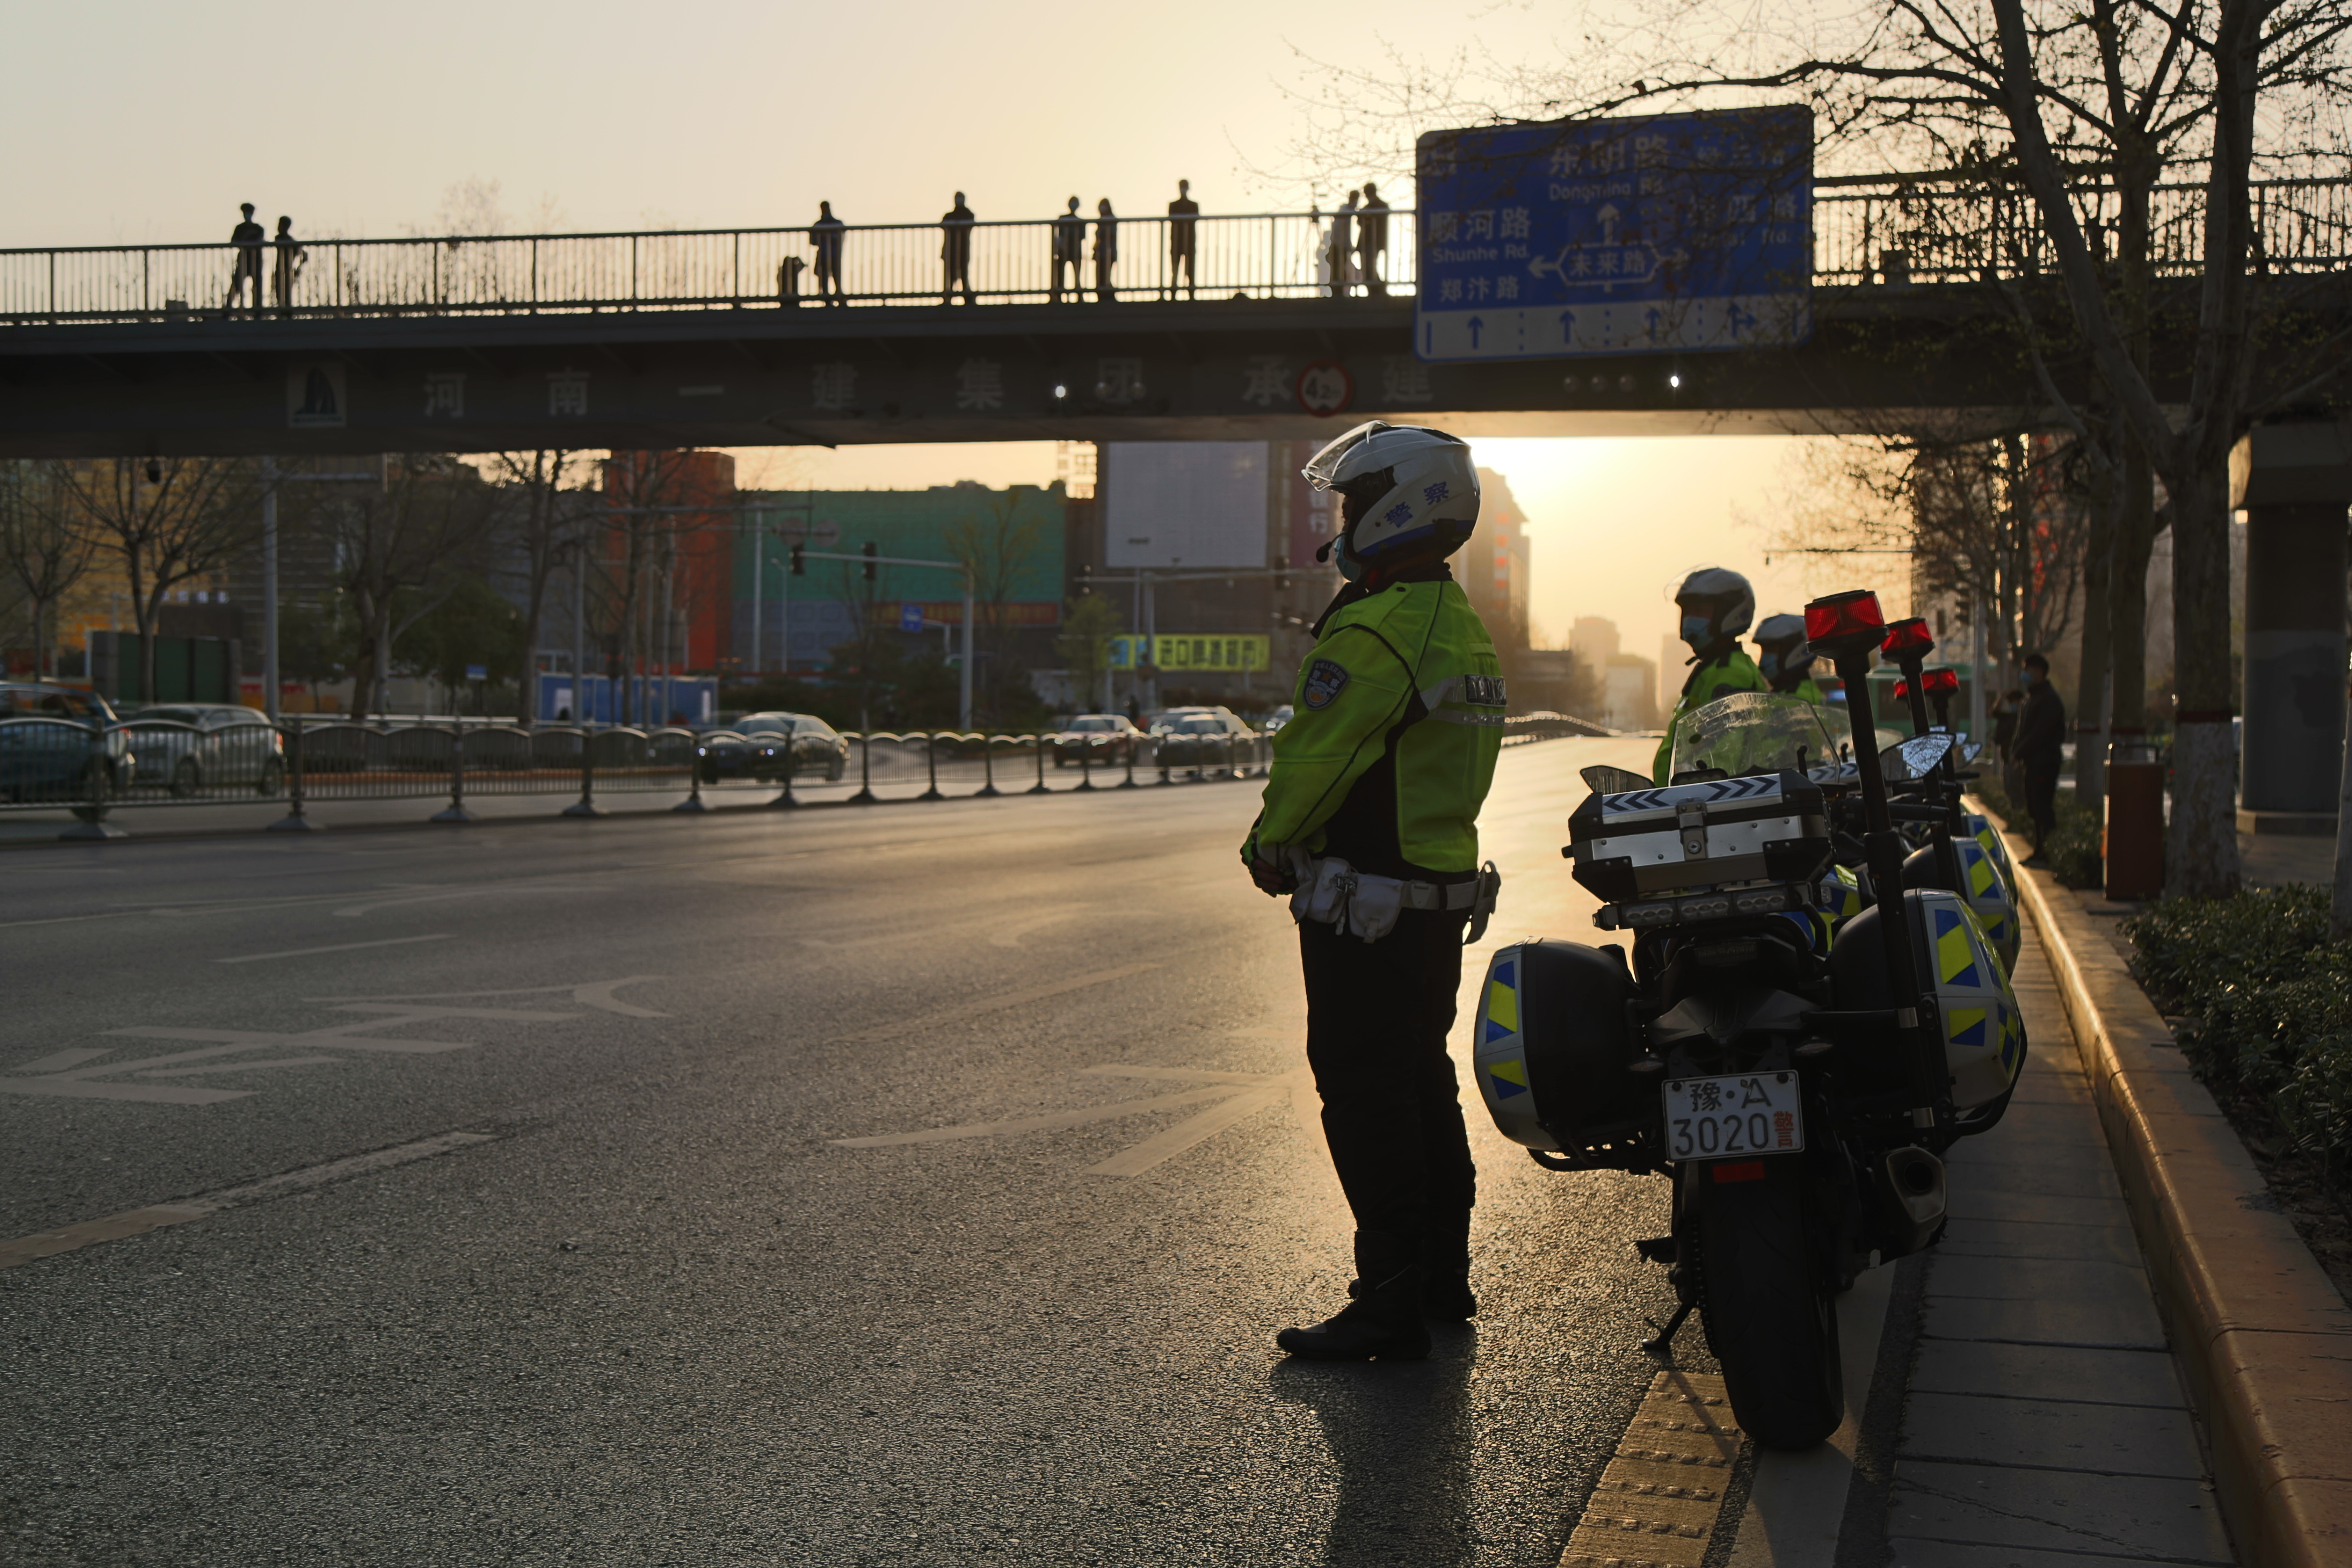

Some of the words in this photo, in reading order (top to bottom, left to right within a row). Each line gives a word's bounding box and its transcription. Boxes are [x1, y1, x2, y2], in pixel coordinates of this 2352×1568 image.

[1428, 206, 1532, 242] 顺河路
[1432, 244, 1498, 264] Shunhe
[1505, 242, 1531, 261] Rd.
[1569, 248, 1646, 277] 未来路
[1439, 273, 1520, 303] 郑汴路
[1383, 481, 1449, 529] 警察
[1673, 1112, 1769, 1156] 3020
[1773, 1111, 1794, 1148] 警
